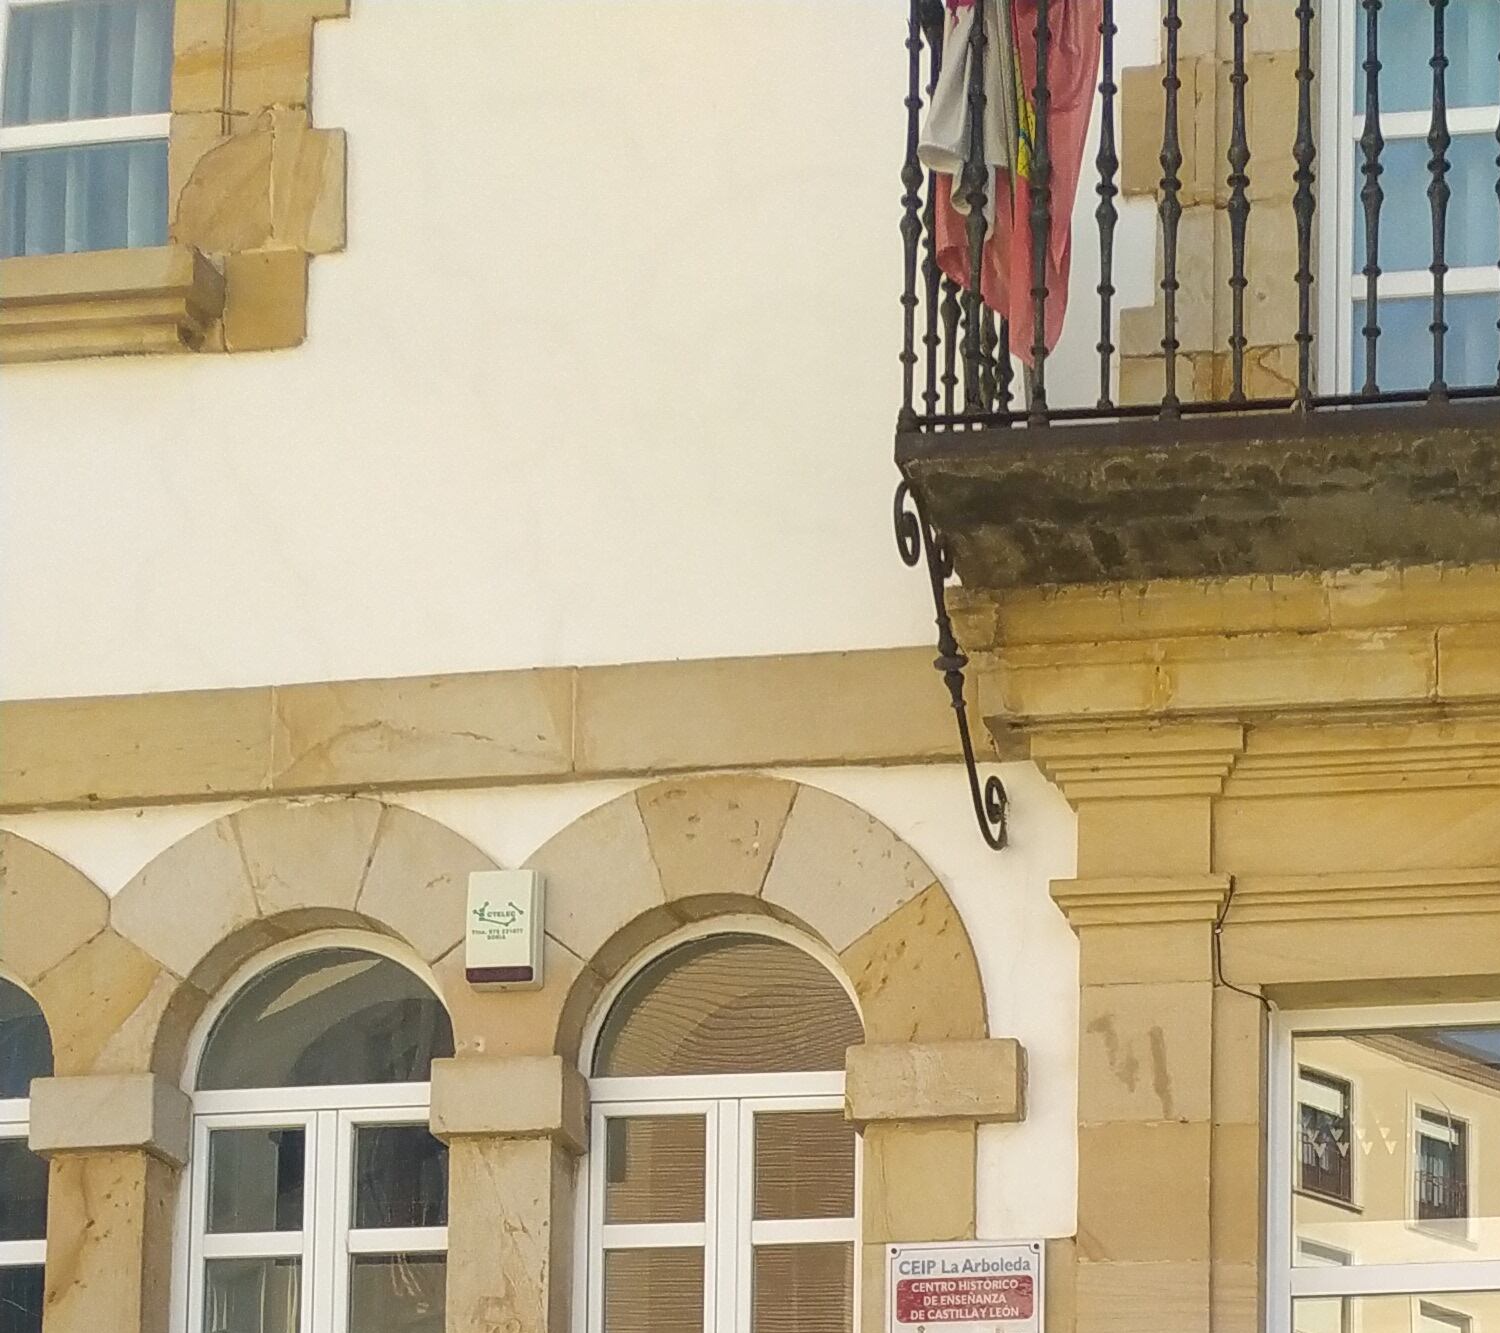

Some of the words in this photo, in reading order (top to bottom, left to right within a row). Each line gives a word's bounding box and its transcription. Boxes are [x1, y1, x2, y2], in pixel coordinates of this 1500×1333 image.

[899, 1260, 936, 1276] CEIP
[942, 1260, 959, 1274] La
[962, 1257, 1031, 1273] Arboleda
[912, 1282, 956, 1292] CENTRO
[959, 1278, 1019, 1291] HISTÓRICO
[924, 1296, 939, 1306] DE
[941, 1293, 1007, 1306] ENSEÑANZA
[910, 1310, 925, 1320] DE
[927, 1308, 978, 1320] CASTILLA
[978, 1308, 988, 1318] Y
[990, 1305, 1020, 1318] LEÓN
